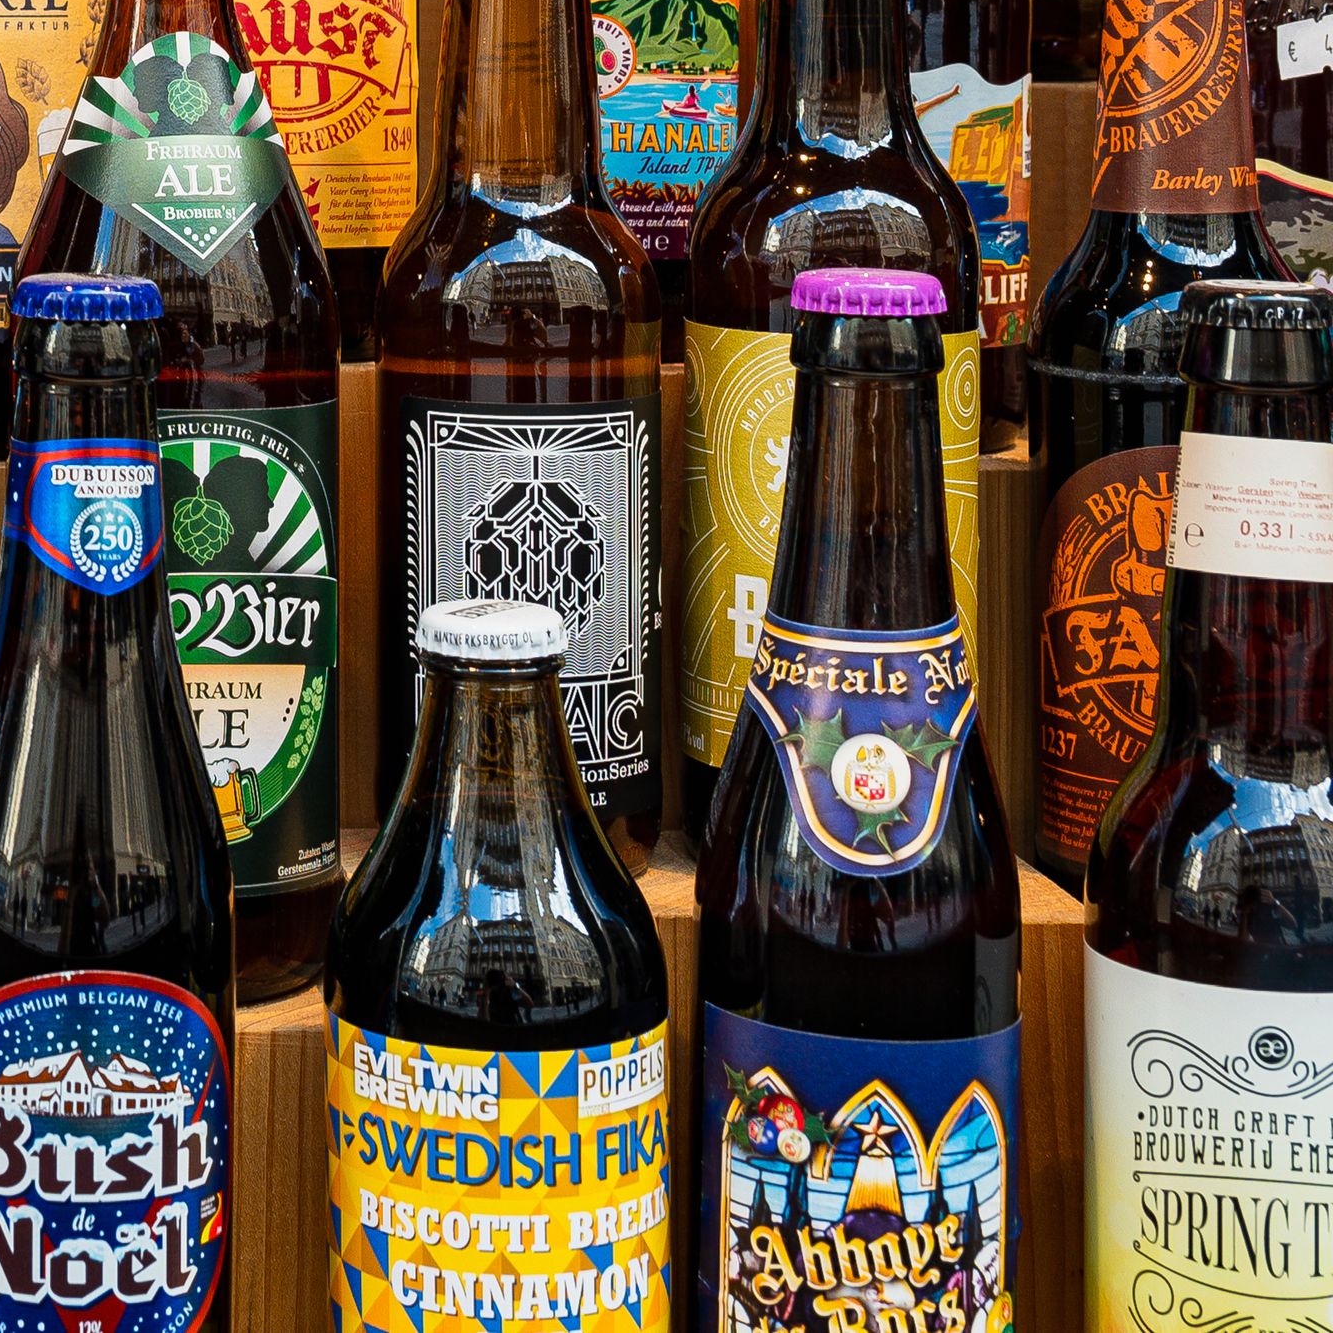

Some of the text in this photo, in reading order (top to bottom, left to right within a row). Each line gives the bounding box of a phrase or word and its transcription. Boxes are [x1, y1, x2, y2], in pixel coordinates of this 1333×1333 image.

[614, 47, 632, 85] GUAVA
[146, 139, 243, 162] FREIRAUM
[381, 126, 412, 154] 1849
[155, 164, 236, 198] ALE
[638, 156, 692, 176] Island
[1151, 169, 1224, 191] Barley
[620, 201, 675, 214] brewed with
[167, 422, 291, 460] FRUCHTIG. FREI.
[53, 465, 155, 486] DUBUISSON
[77, 483, 141, 497] ANNO 1769
[83, 523, 134, 552] 250
[1239, 519, 1284, 539] 0,33
[753, 636, 908, 697] Spéciale
[1040, 728, 1077, 761] 1237
[78, 991, 148, 1010] BELGIAN
[153, 1000, 183, 1023] BEER
[583, 1048, 664, 1102] POPPELS
[353, 1069, 499, 1121] BREWING
[1235, 1110, 1312, 1138] CRAFT
[358, 1108, 666, 1188] SWEDISH FIKA
[1133, 1133, 1274, 1171] BROUWERIJ
[72, 1206, 95, 1231] de
[359, 1183, 667, 1253] BISCOTTI BREAK
[1139, 1186, 1292, 1280] SPRING
[750, 1215, 965, 1307] Abbaye
[391, 1253, 651, 1322] CINNAMON
